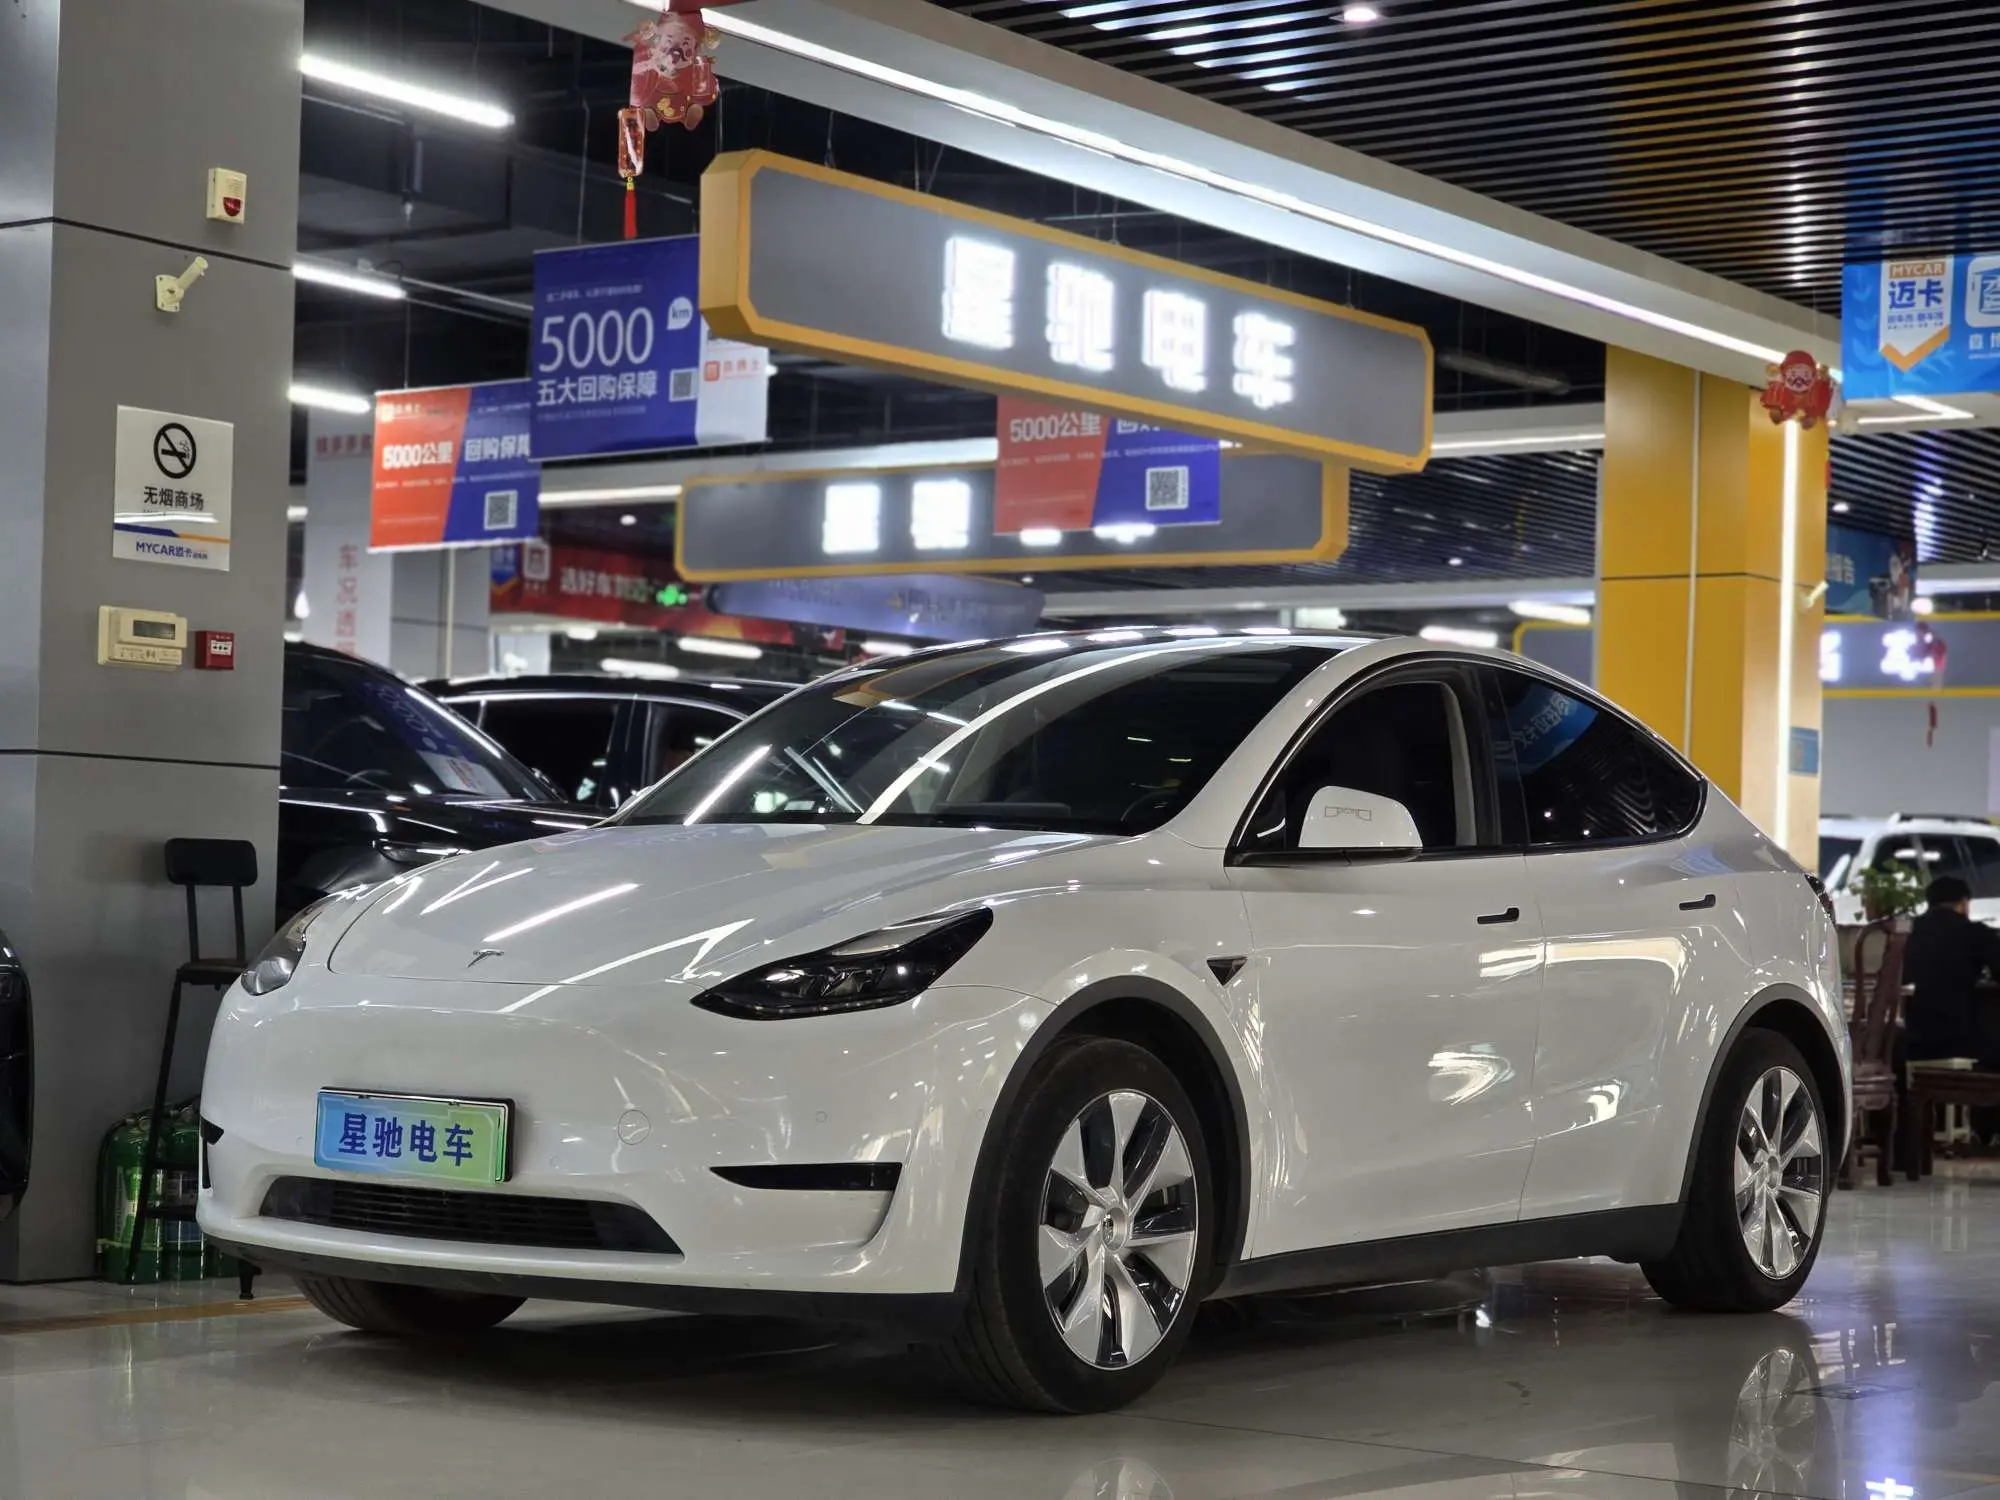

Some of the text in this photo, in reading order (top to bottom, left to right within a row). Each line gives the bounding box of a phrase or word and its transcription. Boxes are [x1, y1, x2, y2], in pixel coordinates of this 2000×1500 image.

[1891, 263, 1943, 276] MYCAR
[1888, 279, 1944, 309] 迈卡
[538, 306, 690, 373] 5000 km
[536, 370, 658, 407] 五大回购保障
[1010, 411, 1102, 443] 5000公里
[143, 486, 205, 511] 无烟商场
[338, 1112, 474, 1167] 星驰电车
